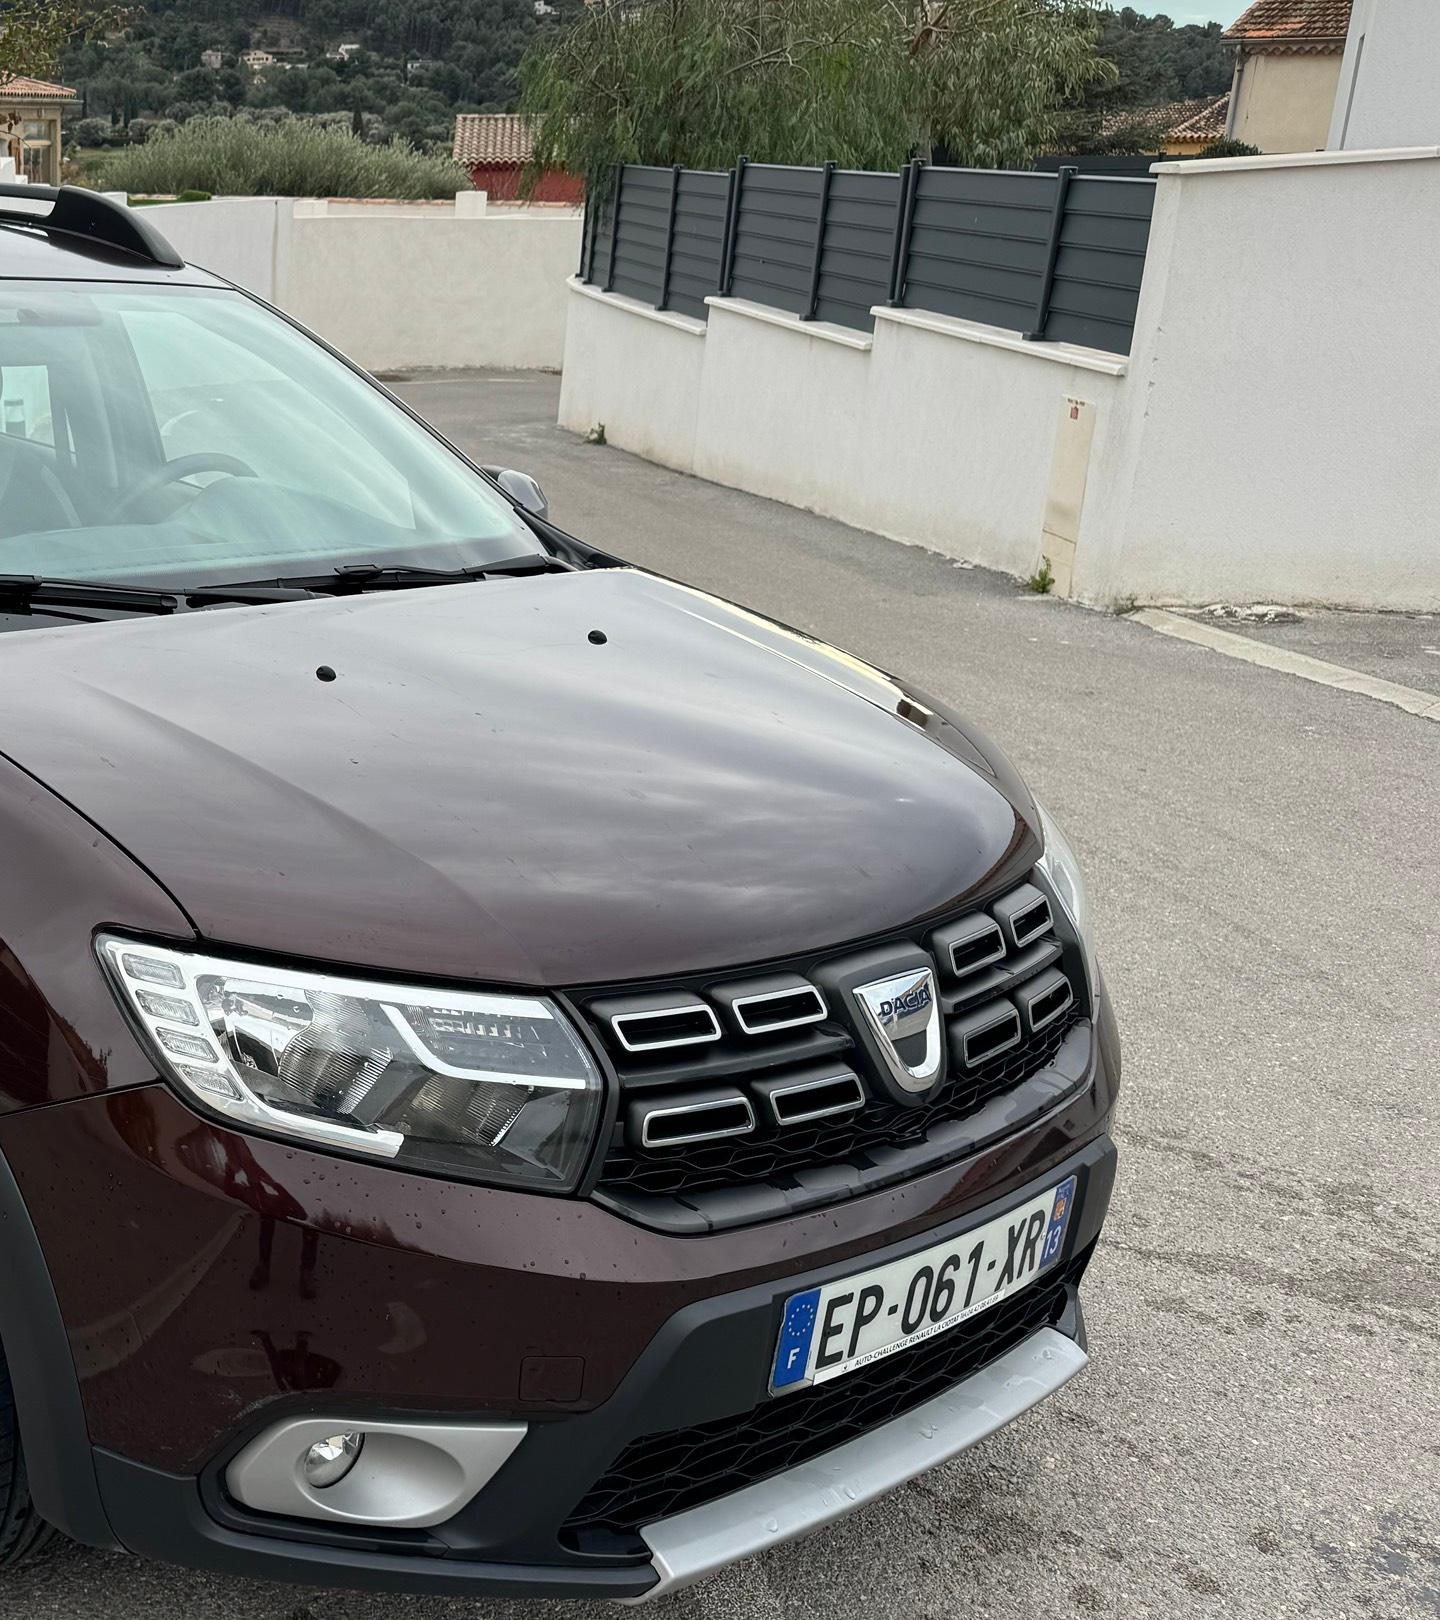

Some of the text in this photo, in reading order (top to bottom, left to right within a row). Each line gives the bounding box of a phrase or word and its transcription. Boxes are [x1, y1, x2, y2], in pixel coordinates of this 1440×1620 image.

[879, 984, 932, 1017] DACIA
[1044, 1225, 1062, 1259] 13
[815, 1209, 1046, 1370] EP-061-XR
[855, 1339, 909, 1367] AUTO-CHALLENGE
[908, 1327, 934, 1344] RENAULT
[941, 1314, 960, 1329] CIOTAT
[787, 1348, 800, 1369] F
